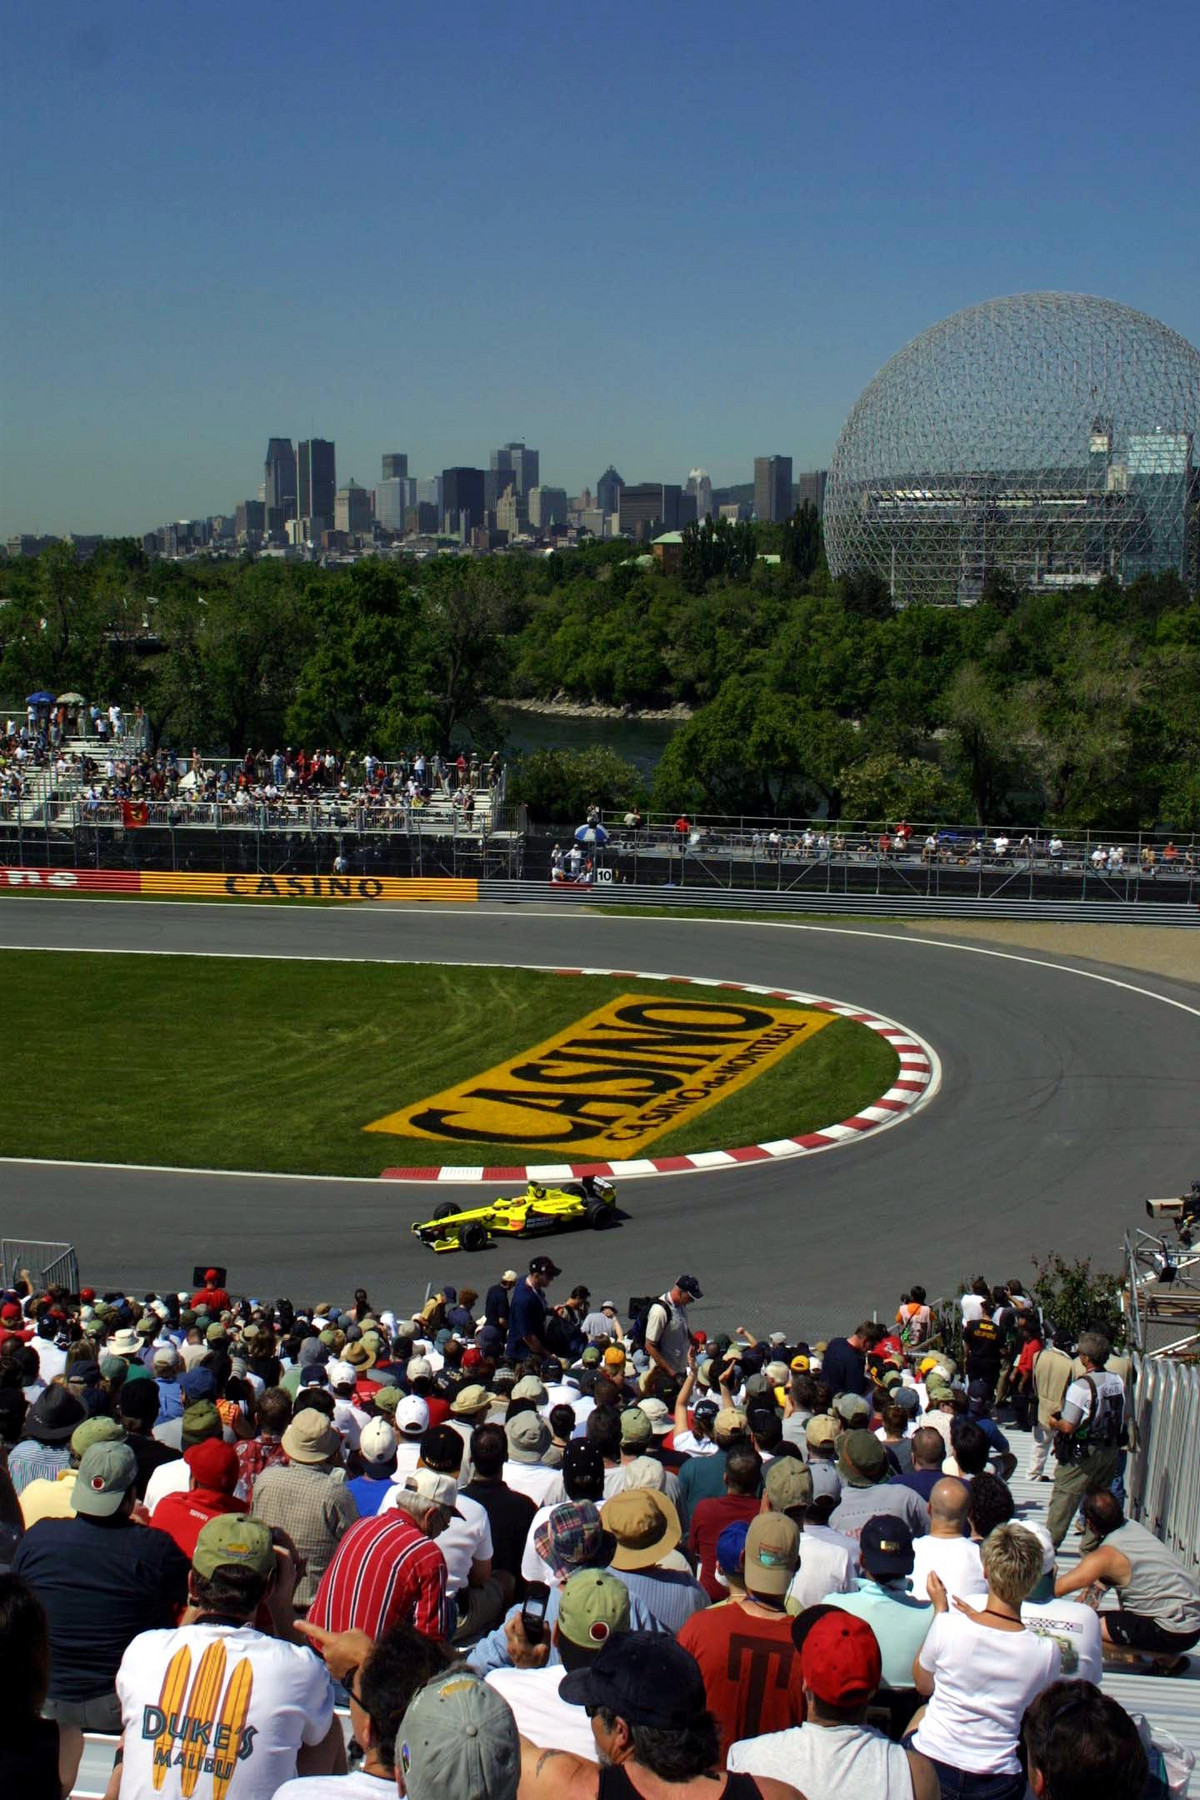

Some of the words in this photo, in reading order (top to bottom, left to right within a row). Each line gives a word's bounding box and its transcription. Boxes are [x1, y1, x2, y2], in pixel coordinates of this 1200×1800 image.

[0, 870, 78, 887] ne
[224, 876, 383, 899] CASINO
[598, 870, 611, 881] 10
[409, 1002, 774, 1143] CASINO
[605, 1088, 711, 1140] CASINO
[713, 1022, 807, 1074] MONTREAL
[142, 1704, 259, 1760] DUKE'S
[154, 1747, 232, 1780] MALIBU
